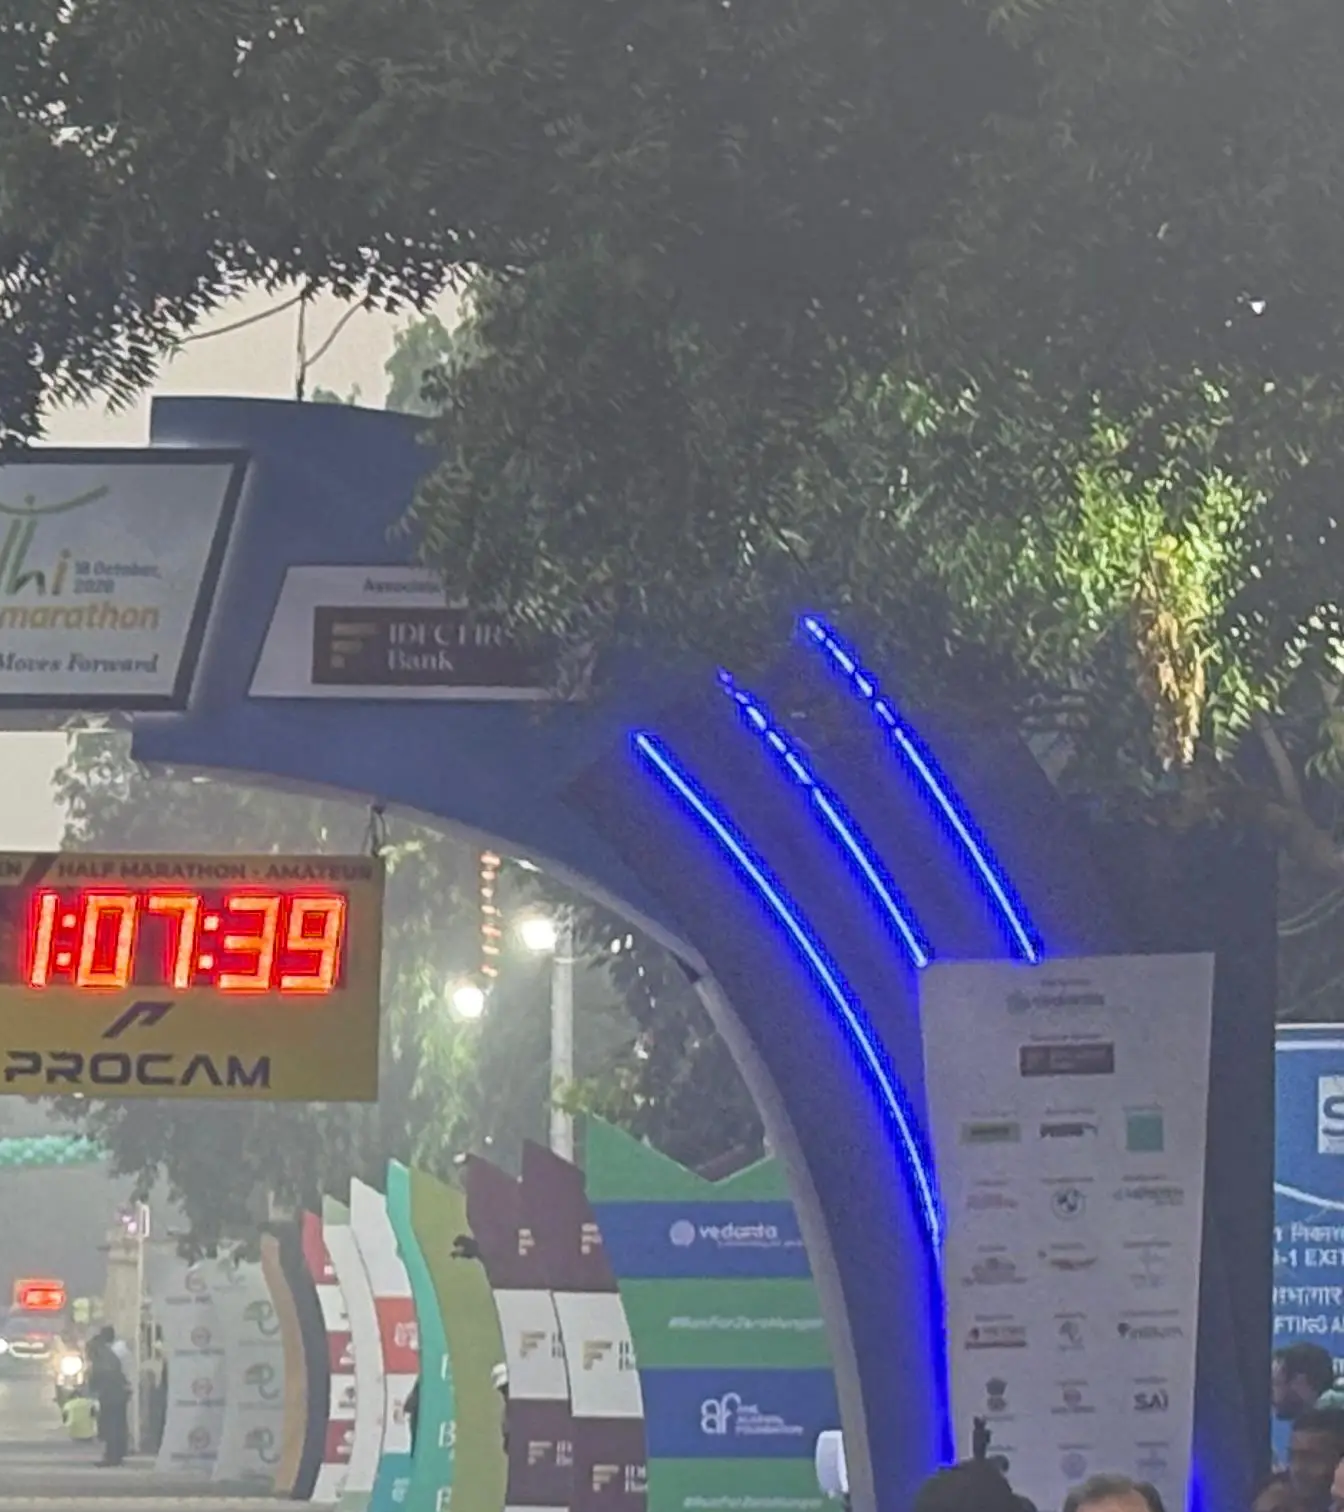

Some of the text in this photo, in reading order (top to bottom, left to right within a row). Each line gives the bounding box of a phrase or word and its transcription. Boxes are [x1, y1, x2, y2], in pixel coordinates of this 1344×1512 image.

[67, 652, 160, 674] Forward
[386, 649, 455, 672] Bank
[57, 861, 116, 878] HALF
[119, 862, 248, 880] MARATHON
[264, 862, 374, 882] AMATEUR
[26, 889, 348, 994] 1:07:39
[3, 1049, 273, 1089] PROCAM
[698, 1222, 779, 1240] vedanta
